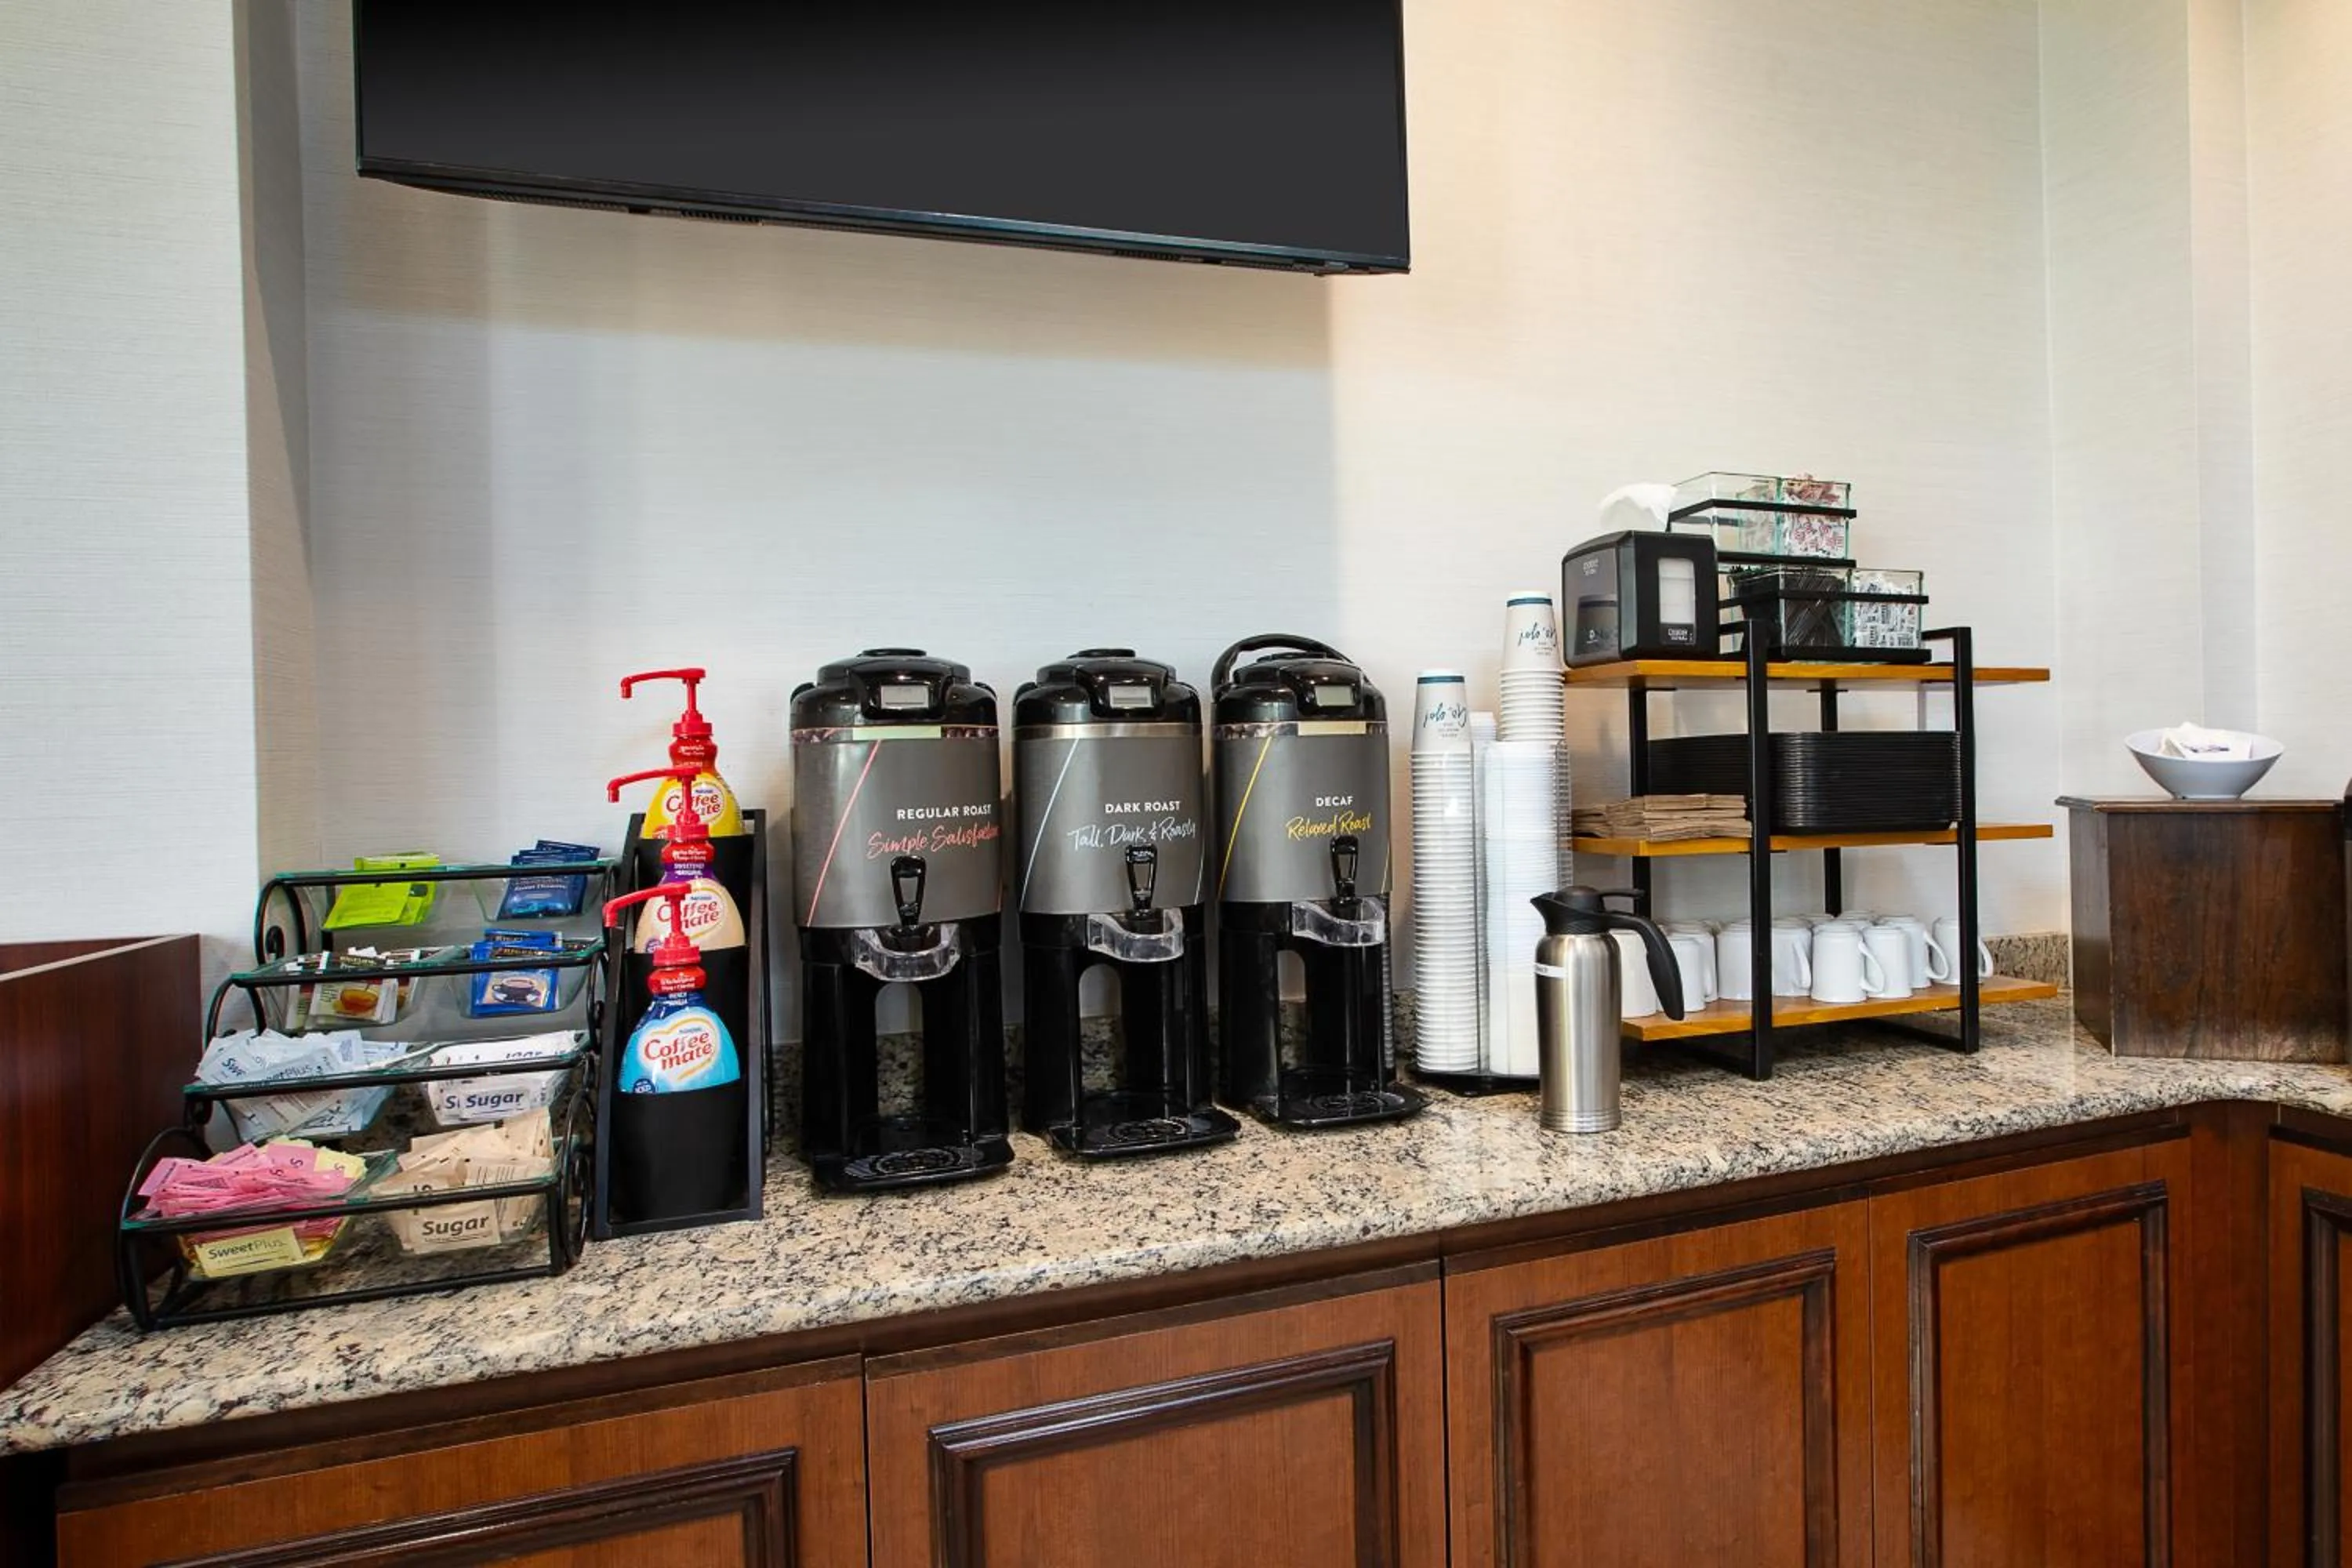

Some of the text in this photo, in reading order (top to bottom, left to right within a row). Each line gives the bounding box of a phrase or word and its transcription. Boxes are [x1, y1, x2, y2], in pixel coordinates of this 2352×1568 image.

[666, 794, 719, 812] Cfee
[1105, 800, 1181, 814] DARK ROAST
[1316, 796, 1354, 807] DECAF
[897, 804, 992, 821] REGULAR ROAST
[1105, 824, 1147, 845] Dark
[1286, 810, 1371, 841] Relaxed Roast
[866, 829, 928, 860] Simple
[657, 901, 717, 923] Cffee
[644, 1032, 710, 1061] Coffee
[661, 1043, 713, 1070] mate
[466, 1093, 524, 1109] Sugar
[422, 1215, 490, 1236] Sugar
[208, 1240, 284, 1260] SweetPlus
